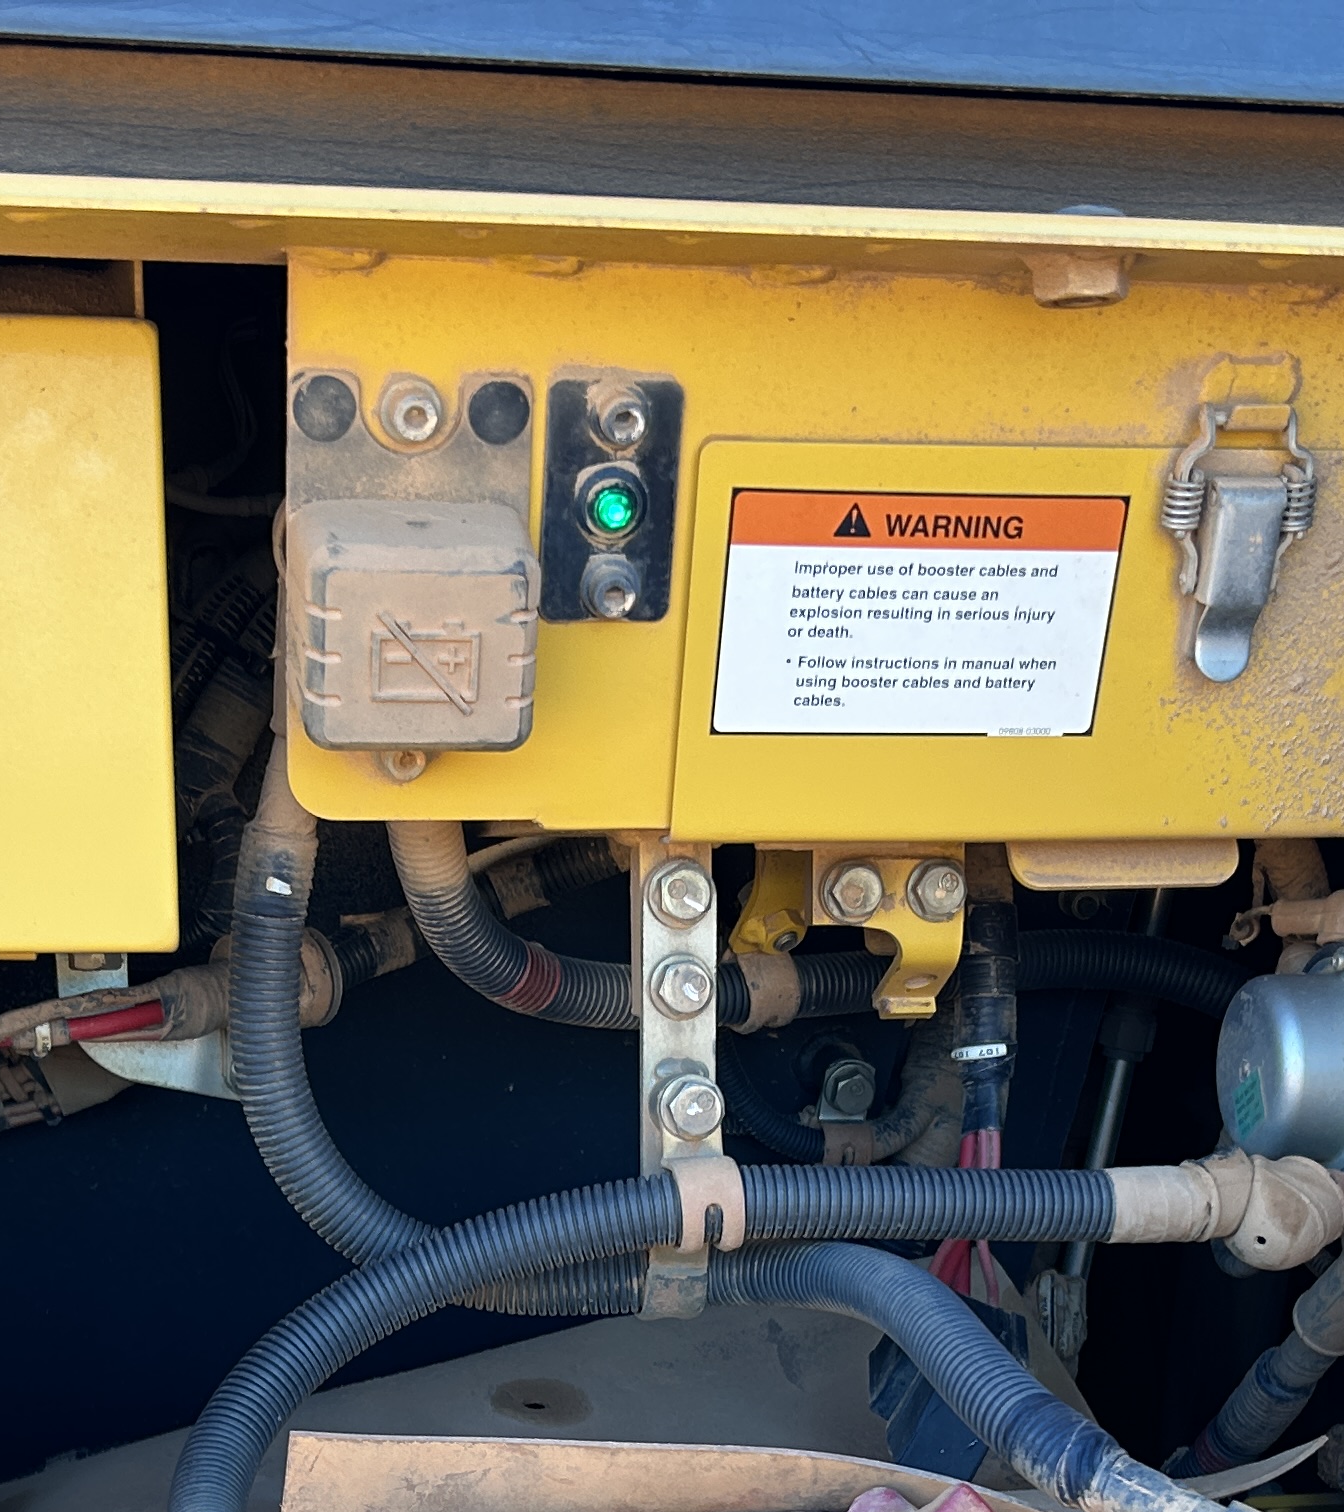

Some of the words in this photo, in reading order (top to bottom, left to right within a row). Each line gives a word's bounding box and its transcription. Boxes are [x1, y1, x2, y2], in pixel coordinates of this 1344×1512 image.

[885, 513, 1024, 540] WARNING
[794, 560, 864, 579] Improper
[867, 565, 894, 576] use
[898, 562, 915, 576] of
[917, 563, 976, 577] booster
[978, 564, 1027, 578] cables
[1030, 564, 1059, 578] and
[791, 584, 845, 603] battery
[848, 586, 898, 600] cables
[901, 589, 929, 601] can
[933, 590, 977, 601] cause
[980, 590, 999, 601] an
[789, 605, 863, 622] explosion
[867, 606, 933, 624] resulting
[937, 606, 951, 621] in
[955, 607, 1010, 621] serious
[1013, 605, 1056, 625] injury
[787, 627, 804, 638] or
[807, 624, 853, 639] death.
[797, 655, 847, 669] Follow
[851, 656, 940, 670] instructions
[943, 656, 957, 670] in
[961, 657, 1015, 670] manual
[1018, 657, 1057, 670] when
[795, 674, 837, 692] using
[841, 675, 899, 689] booster
[902, 675, 950, 689] cables
[953, 675, 982, 689] and
[985, 676, 1036, 692] battery
[793, 693, 846, 708] cables.
